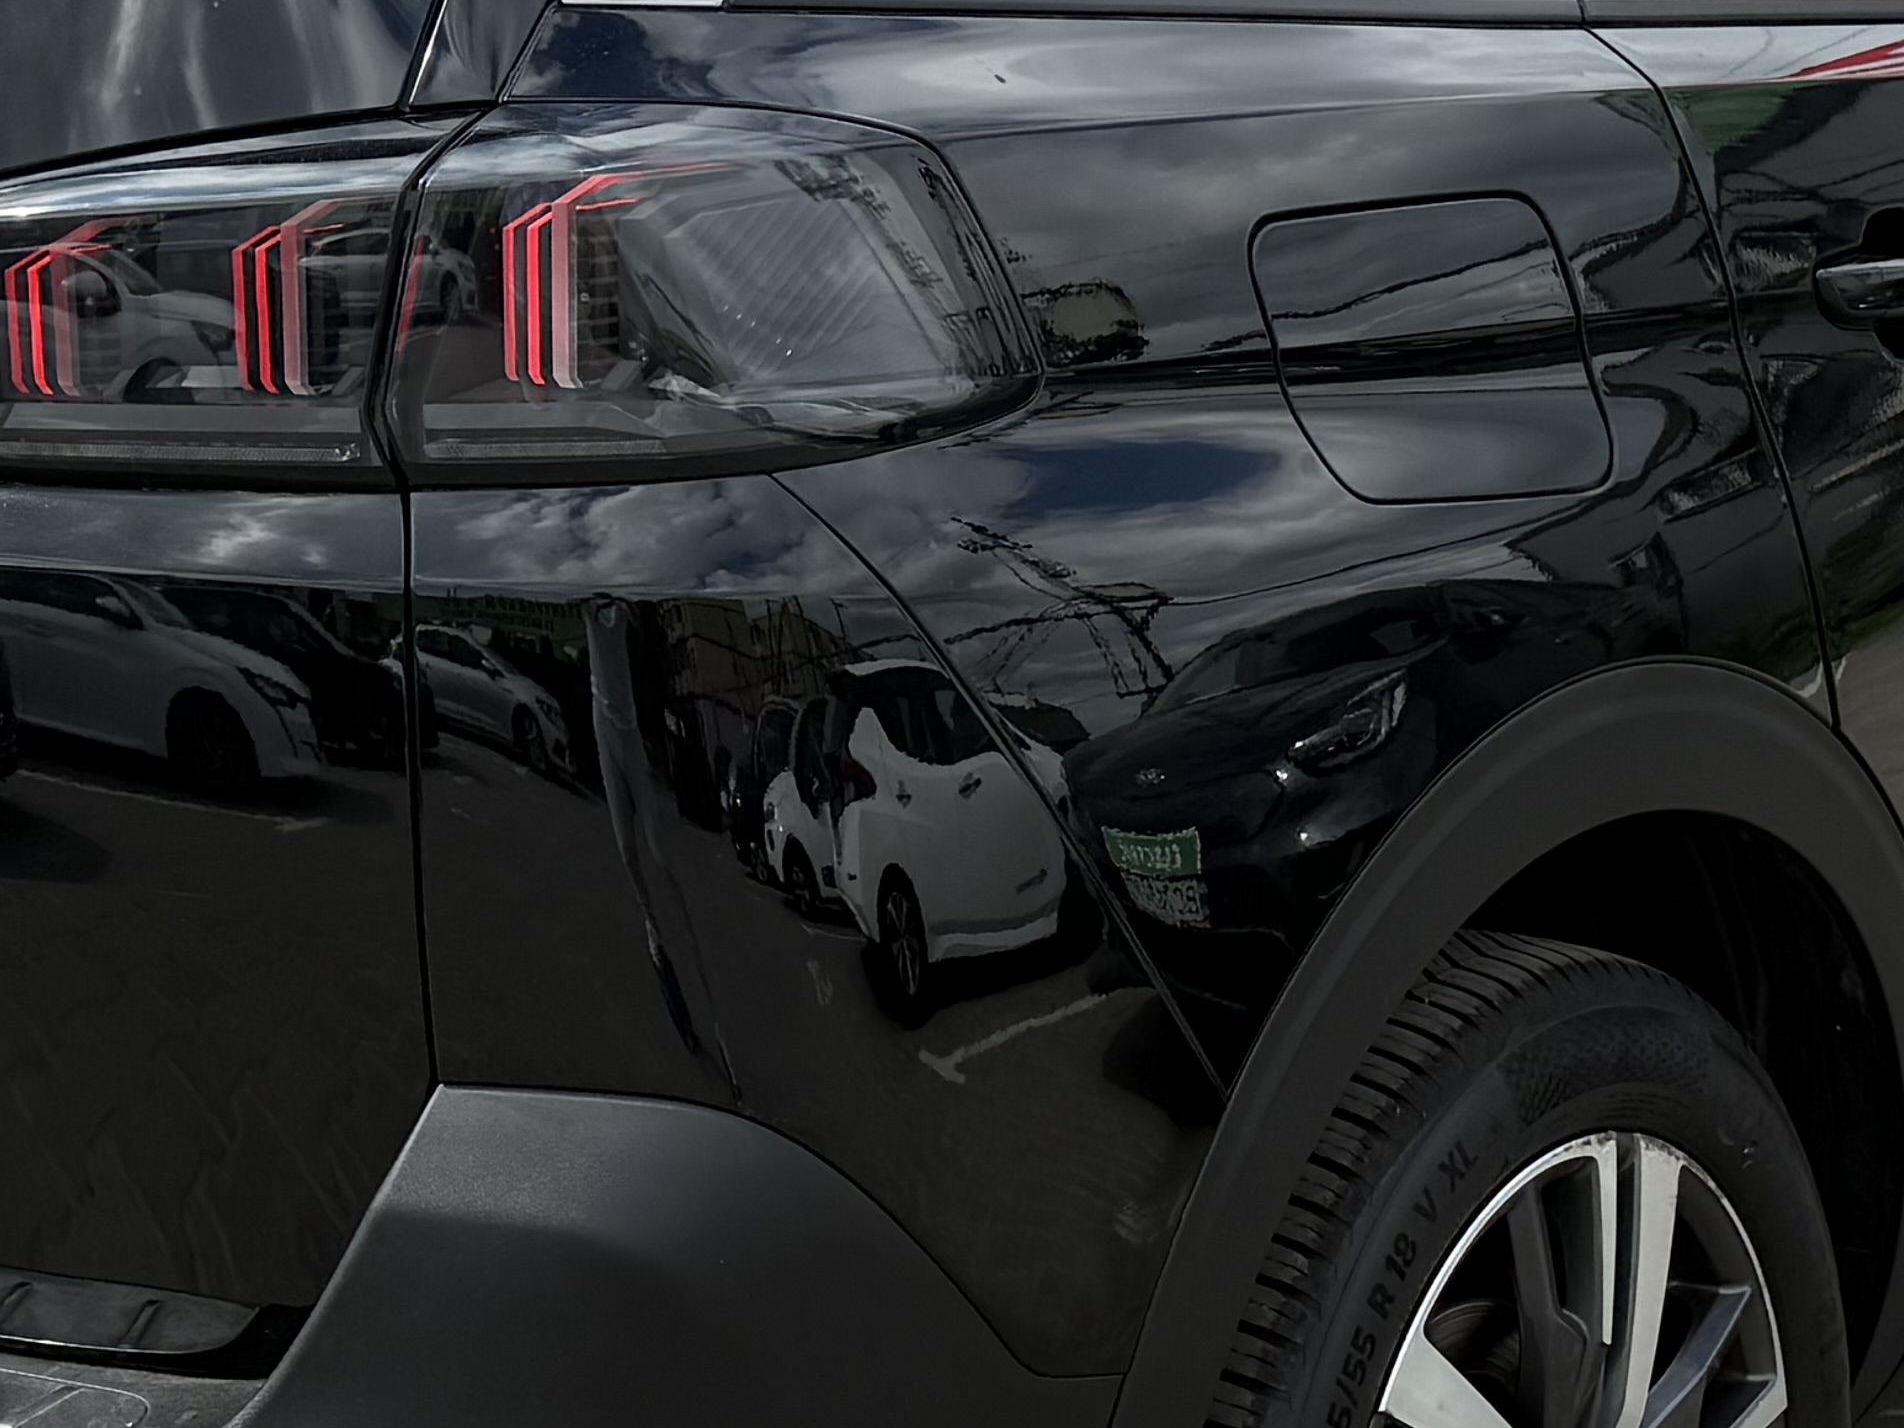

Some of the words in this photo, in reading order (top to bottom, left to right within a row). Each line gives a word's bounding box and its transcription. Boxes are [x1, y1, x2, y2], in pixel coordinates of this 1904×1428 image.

[1366, 1281, 1396, 1320] R
[1384, 1230, 1418, 1282] 18
[1411, 1184, 1439, 1224] V
[1437, 1138, 1480, 1193] XL
